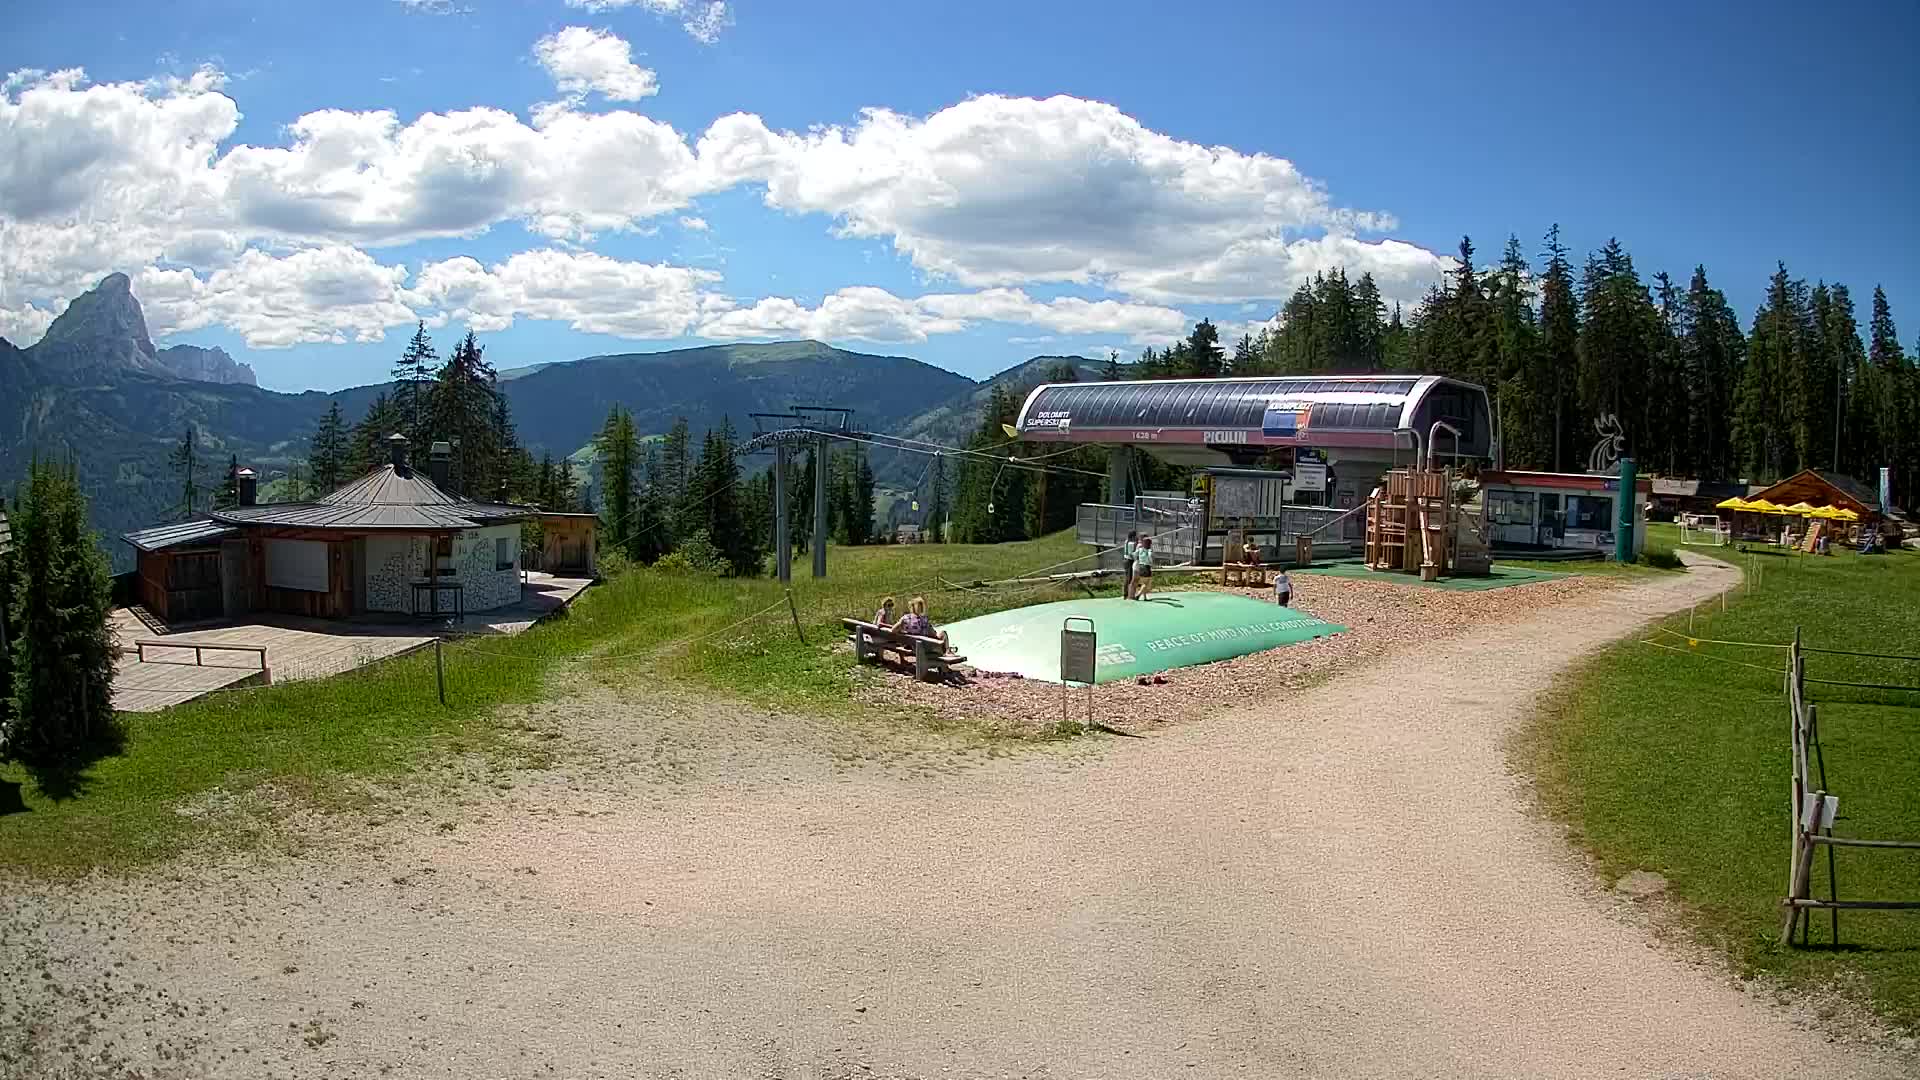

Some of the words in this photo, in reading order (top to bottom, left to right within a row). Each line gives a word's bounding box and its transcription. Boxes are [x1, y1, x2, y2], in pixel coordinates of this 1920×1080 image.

[1037, 411, 1070, 419] DOLOMITI
[1026, 418, 1060, 426] SUPERSKI
[1203, 431, 1248, 444] PICULIN
[1146, 636, 1191, 652] PEACE
[1190, 632, 1207, 643] OF
[1207, 628, 1238, 641] MIND
